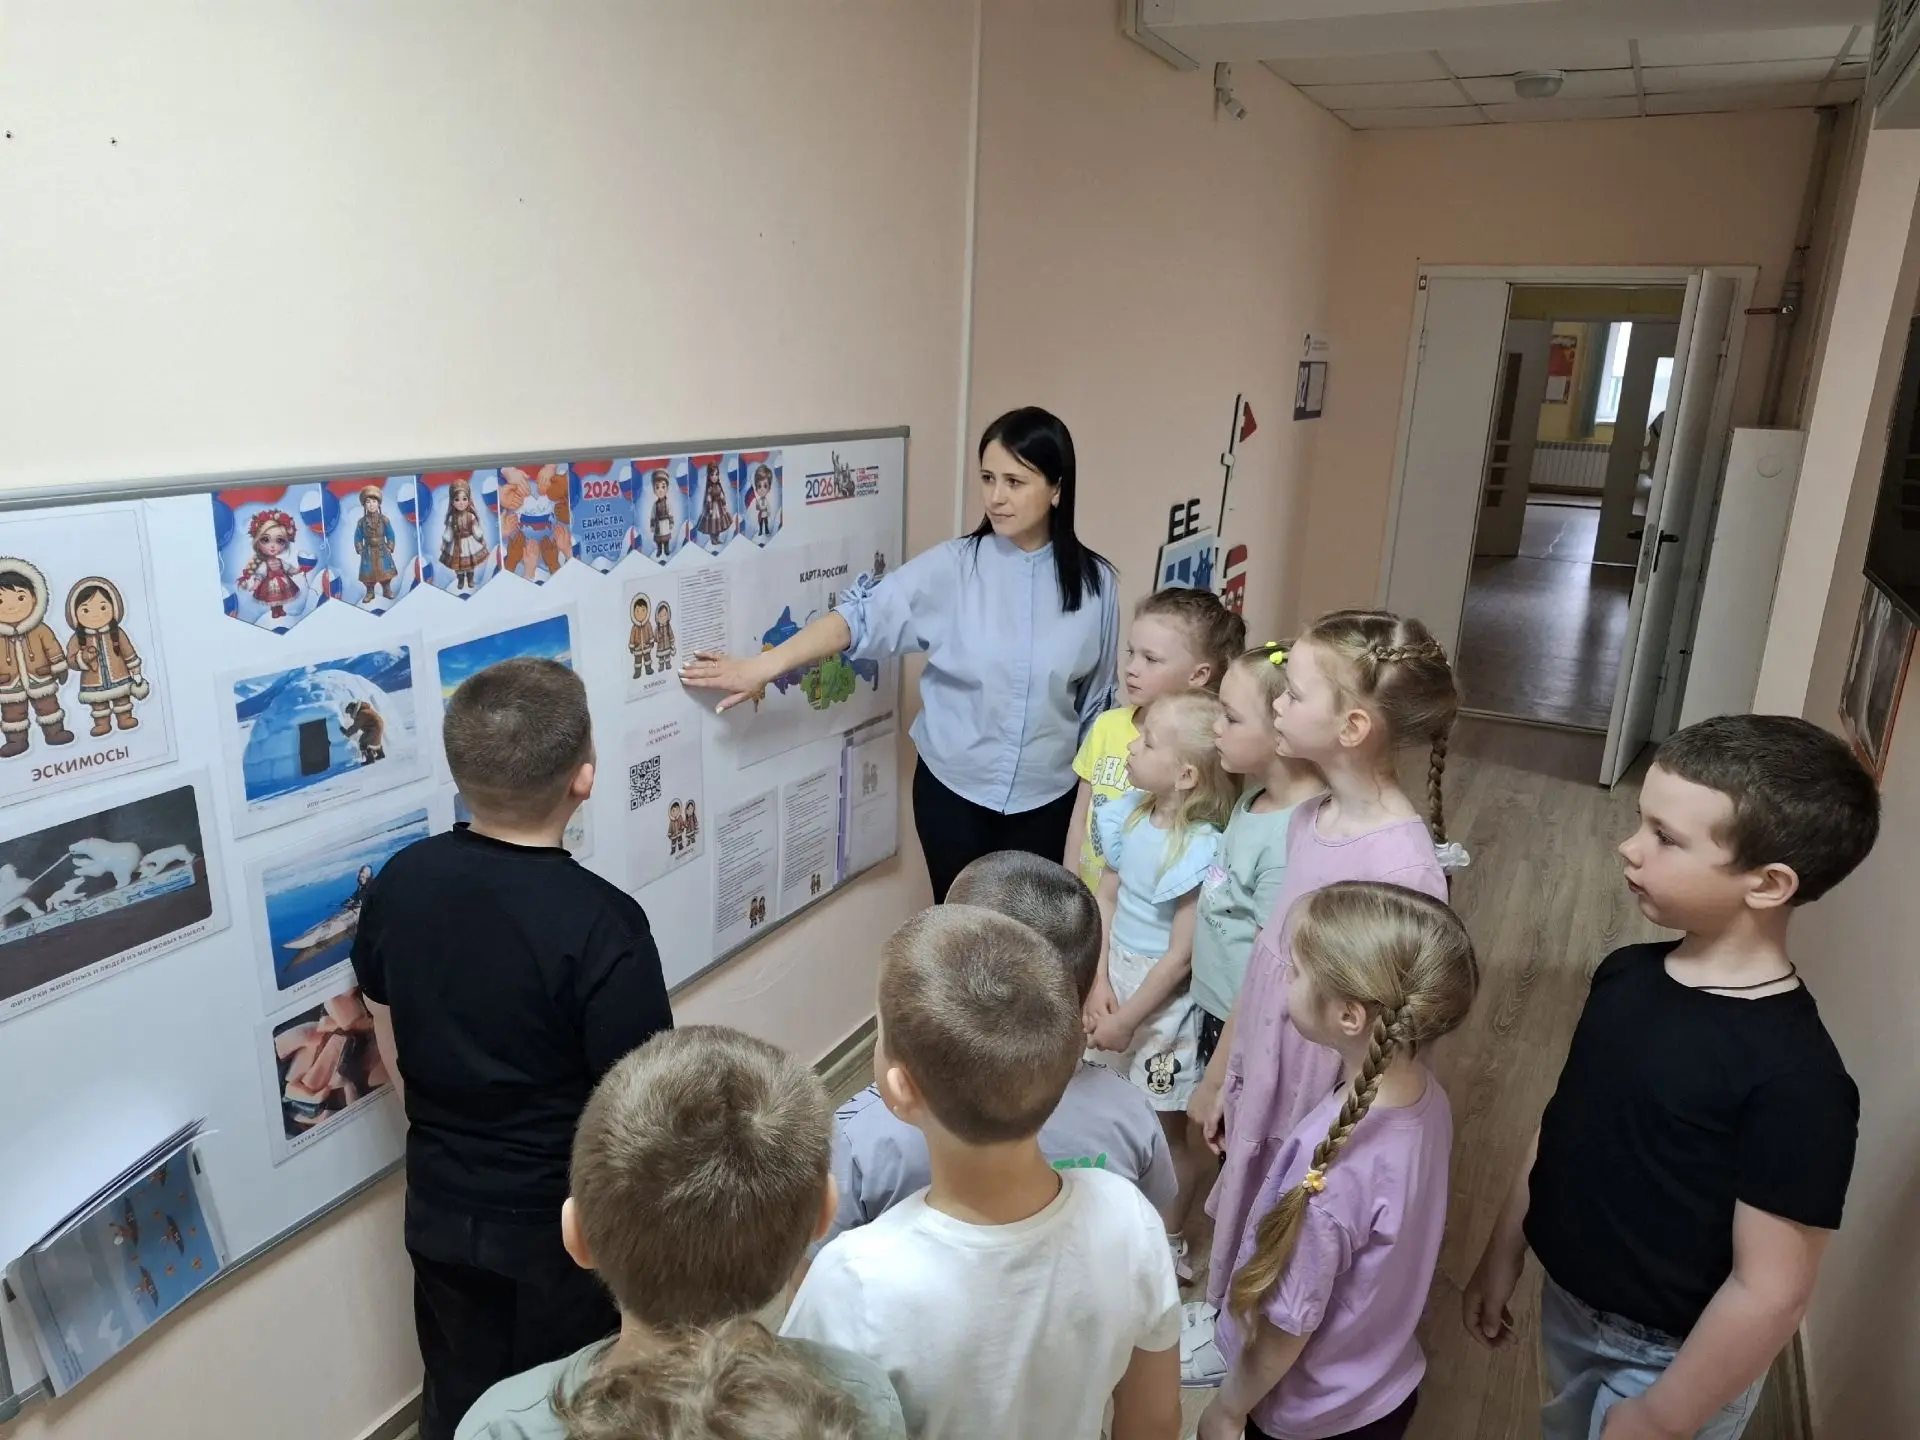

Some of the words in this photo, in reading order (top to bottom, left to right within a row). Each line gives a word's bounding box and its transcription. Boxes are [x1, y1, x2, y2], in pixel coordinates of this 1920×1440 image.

[583, 481, 620, 499] 2026
[805, 477, 834, 499] 2026
[595, 503, 611, 513] ГОД
[582, 515, 624, 528] ЕДИНСТВА
[584, 528, 624, 541] НАРОДОВ
[800, 569, 821, 583] КАРТА
[822, 563, 848, 578] РОССИИ
[31, 746, 129, 782] ЭСКИМОСЫ
[10, 990, 48, 1008] ФИГУРКИ
[49, 971, 92, 992] ЖИВОТНЫХ
[99, 957, 126, 973] ЛЮДЕЙ
